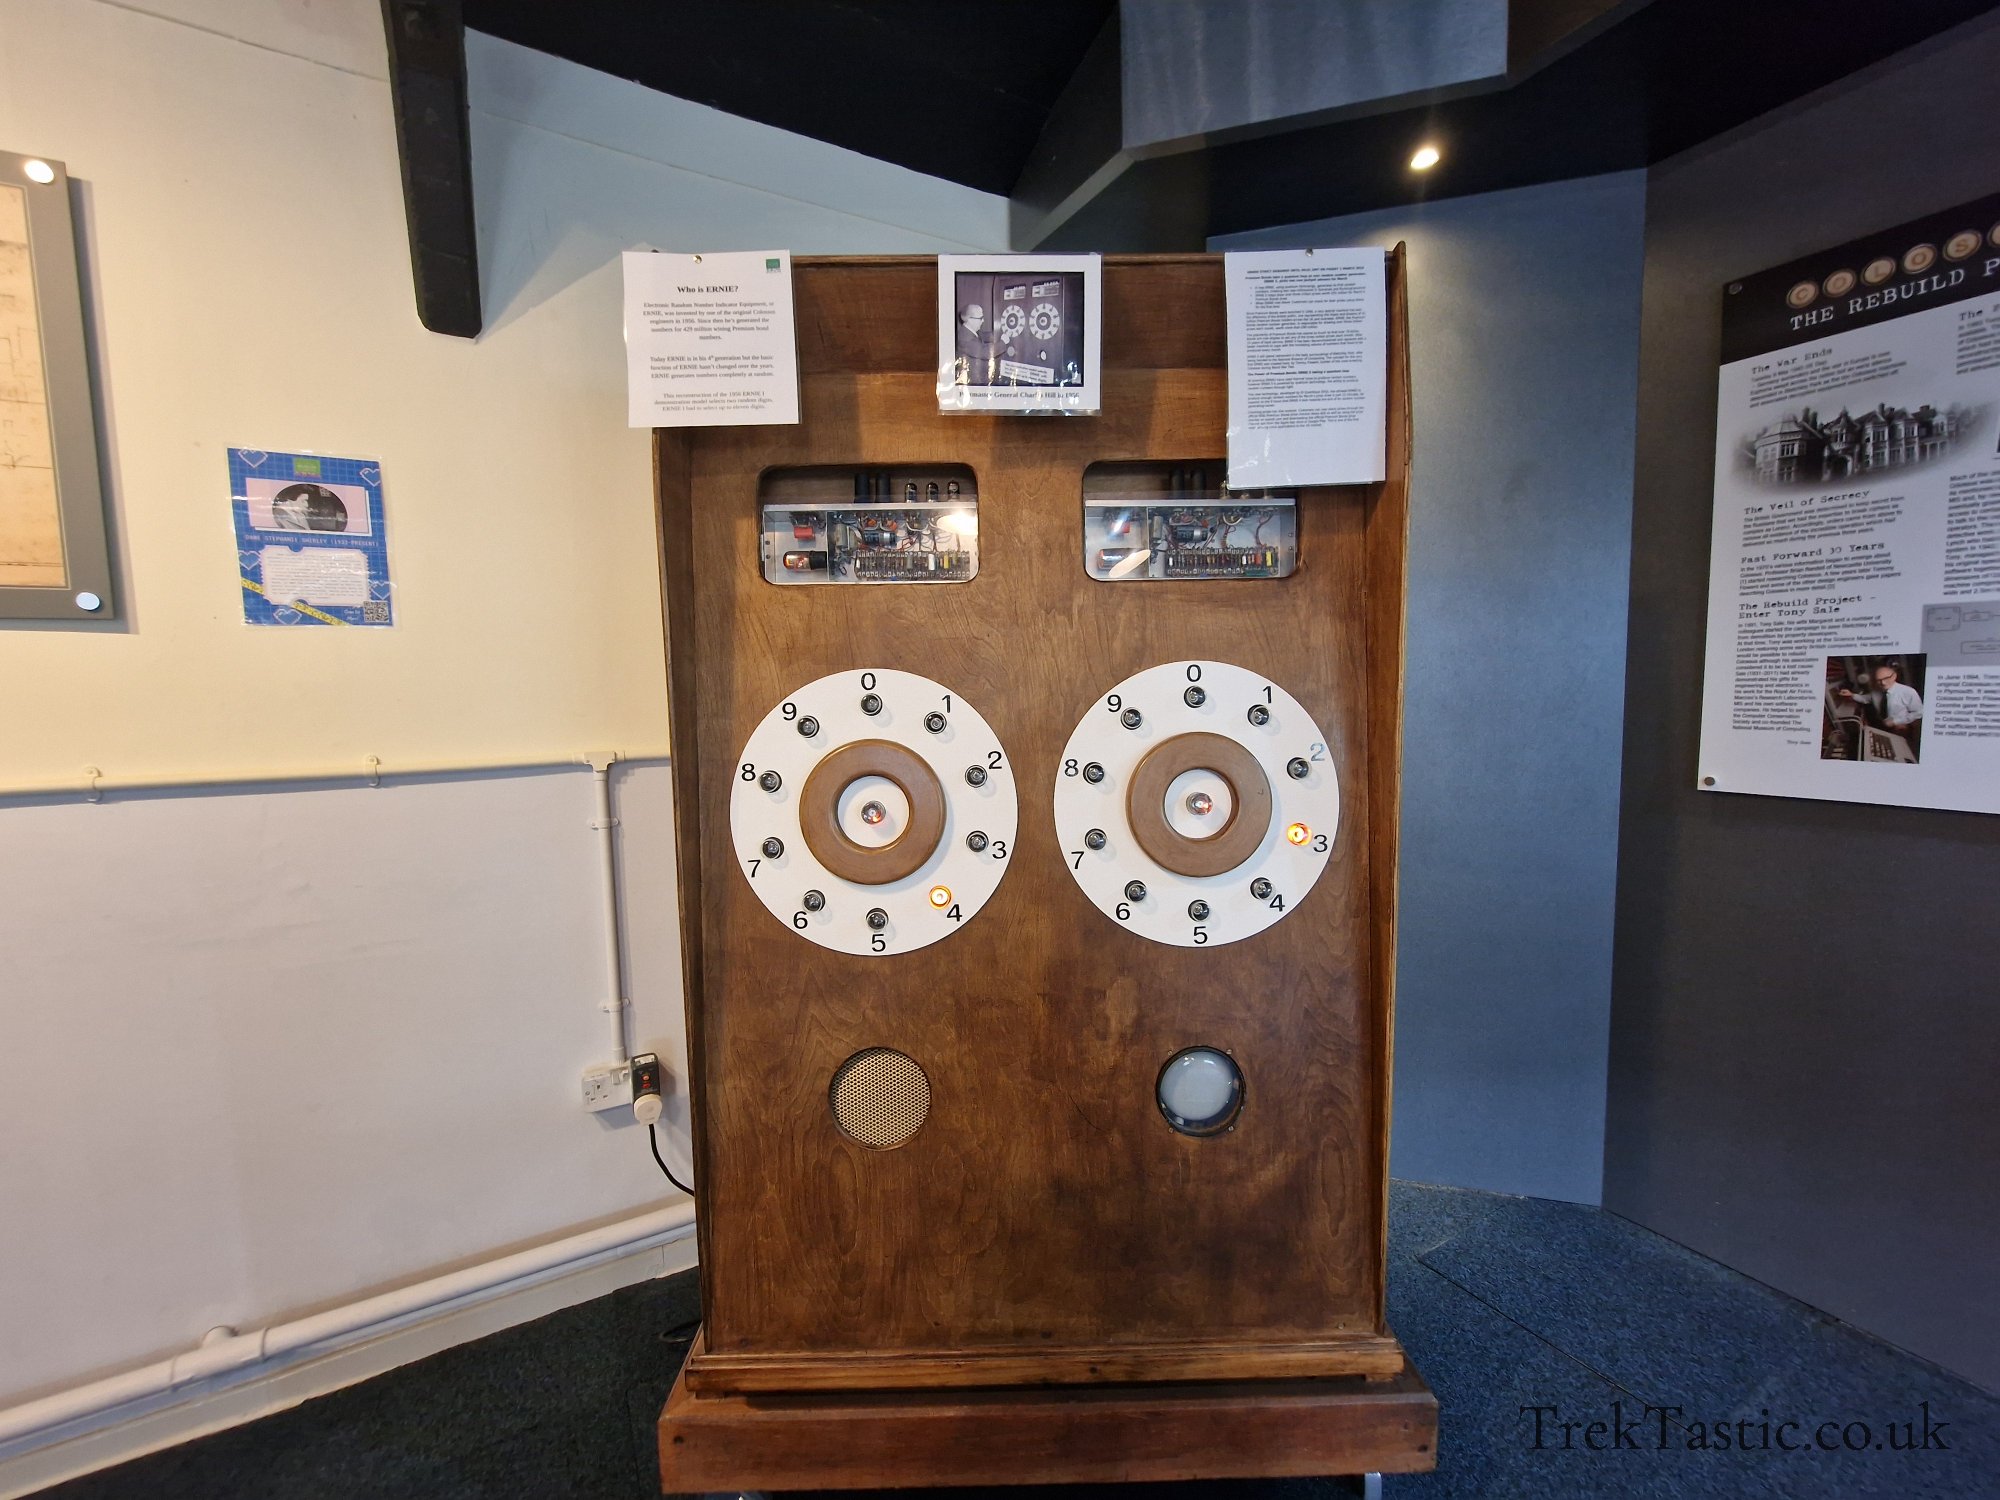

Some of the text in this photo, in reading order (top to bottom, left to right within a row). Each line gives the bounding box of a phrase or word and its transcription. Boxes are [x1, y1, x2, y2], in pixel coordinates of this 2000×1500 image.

[706, 285, 739, 293] ERNIE?
[1790, 306, 1834, 330] THE
[1848, 268, 1965, 315] REBUILD
[1959, 310, 1983, 320] The
[1752, 348, 1832, 374] The War Ends
[1744, 489, 1870, 514] The Veil of Secrecy
[1741, 556, 1766, 564] Fast
[1773, 548, 1822, 560] Forward
[1849, 542, 1885, 552] Years
[1764, 598, 1808, 609] Rebuild
[1816, 595, 1862, 605] Project
[1738, 606, 1840, 619] Enter Tony Sale
[860, 672, 876, 690] 0
[1186, 664, 1202, 682] 0
[942, 694, 951, 713] 1
[1107, 694, 1122, 712] 9
[1262, 686, 1272, 704] 1
[782, 702, 797, 720] 9
[988, 751, 1002, 770] 2
[1310, 742, 1326, 762] 2
[741, 763, 756, 782] 8
[1064, 758, 1079, 777] 8
[992, 840, 1007, 859] 3
[1312, 834, 1328, 852] 3
[748, 860, 761, 878] 7
[1071, 851, 1084, 870] 7
[1116, 902, 1130, 920] 6
[1269, 894, 1285, 912] 4
[793, 911, 808, 929] 6
[946, 904, 962, 922] 4
[871, 934, 886, 952] 5
[1193, 926, 1208, 944] 5
